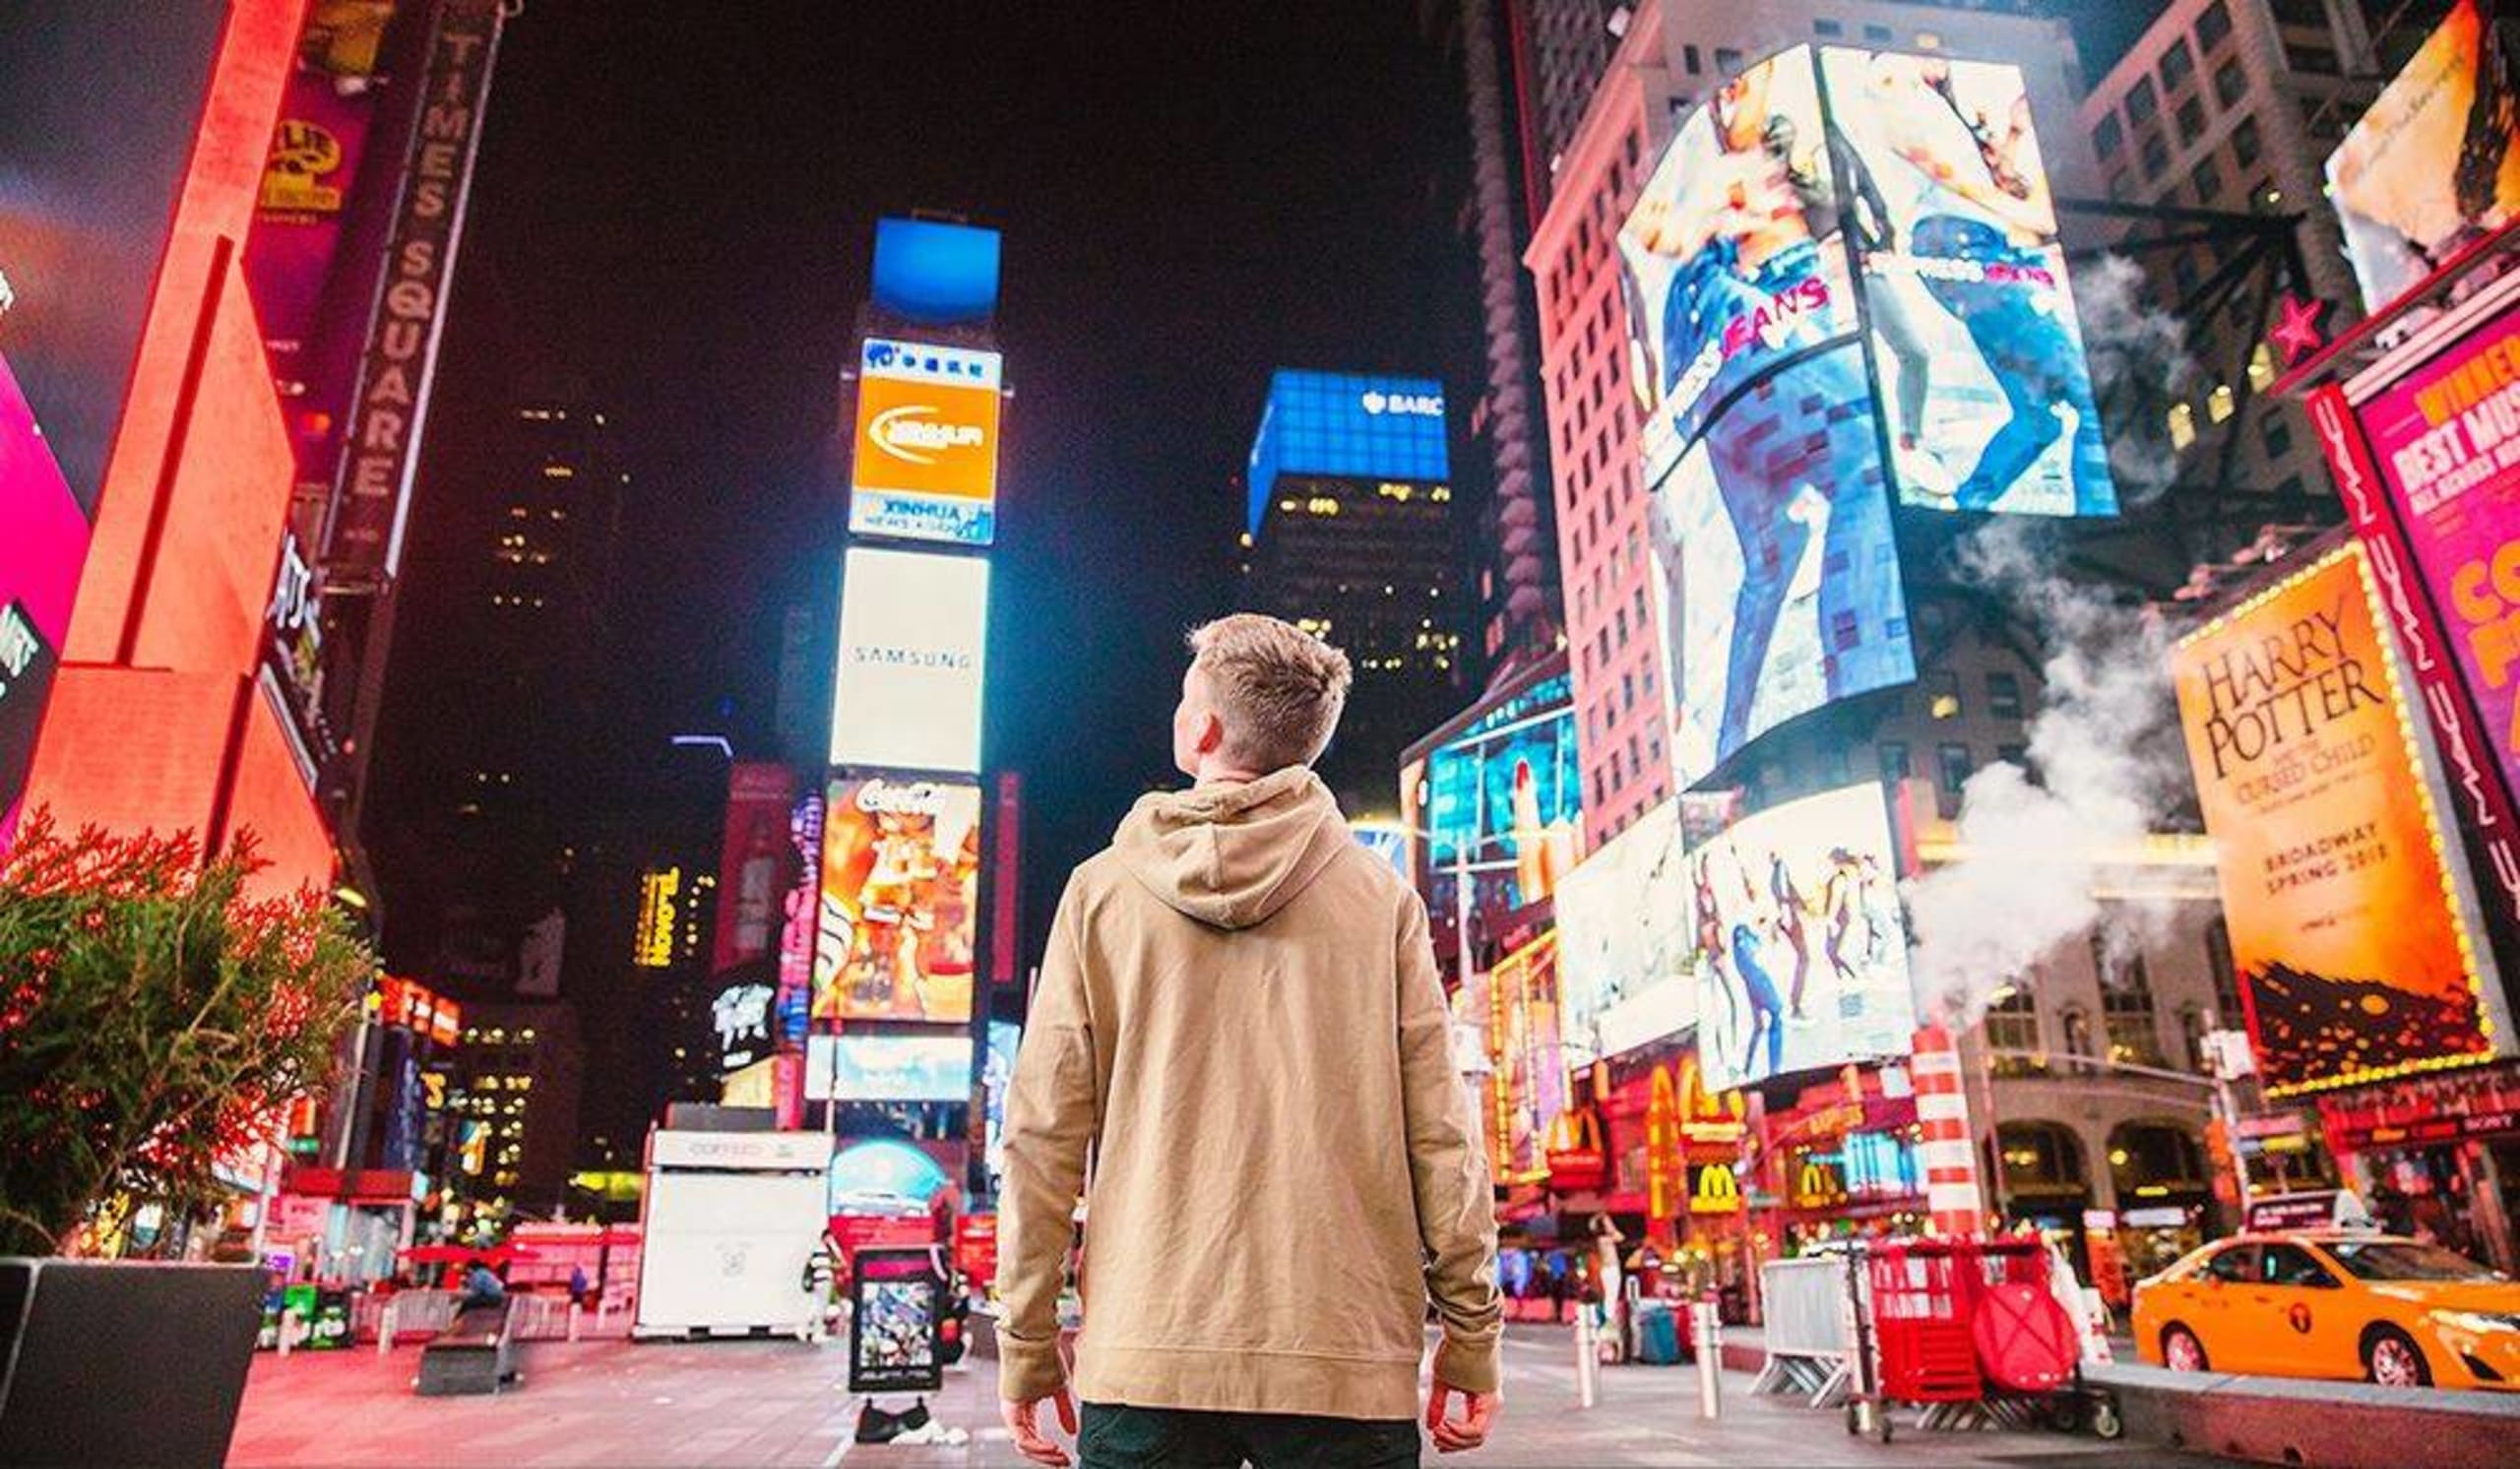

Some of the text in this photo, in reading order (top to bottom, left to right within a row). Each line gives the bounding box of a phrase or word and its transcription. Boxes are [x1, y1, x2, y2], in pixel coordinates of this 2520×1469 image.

[413, 32, 483, 219] TIMES
[351, 239, 435, 496] SQUARE
[2391, 418, 2468, 495] BEST
[885, 498, 961, 521] XINHUA
[853, 646, 973, 670] SAMSUNG
[2204, 593, 2347, 716] HARRY
[2205, 659, 2385, 780] POTTER
[2265, 821, 2377, 873] BROADWAY
[2266, 859, 2339, 897] SPRING
